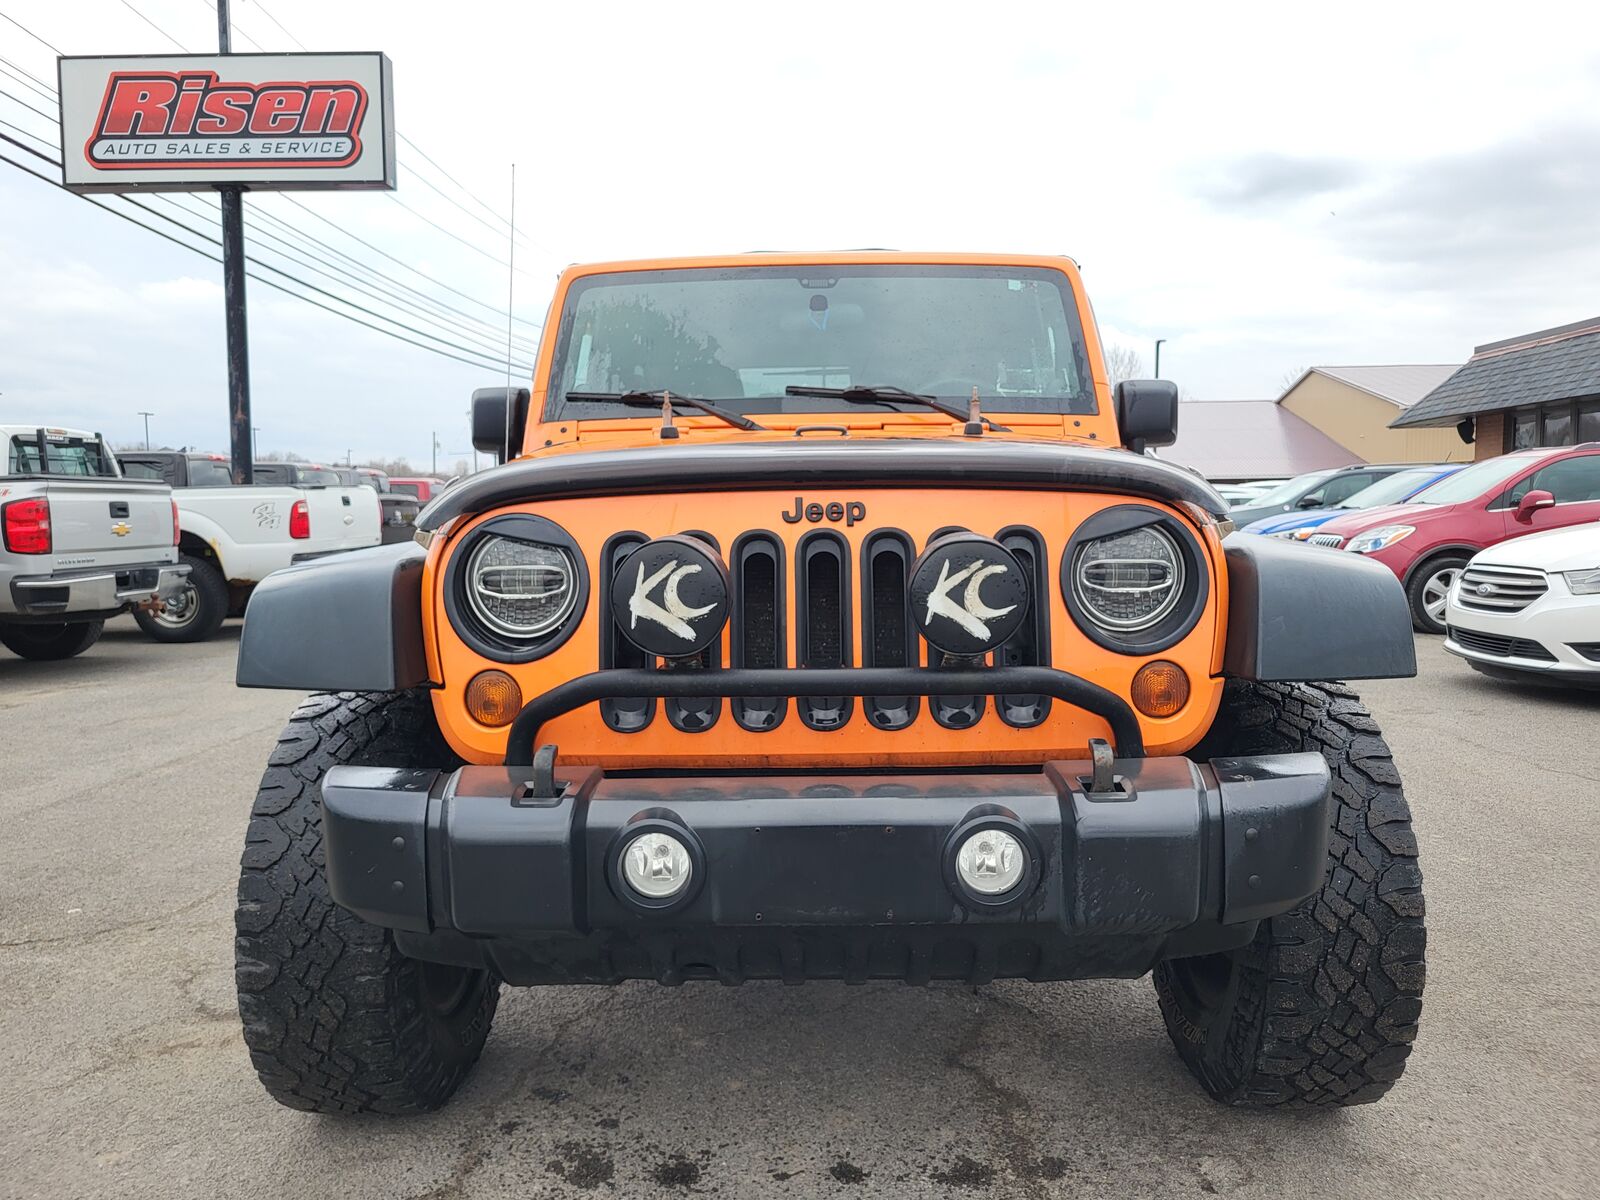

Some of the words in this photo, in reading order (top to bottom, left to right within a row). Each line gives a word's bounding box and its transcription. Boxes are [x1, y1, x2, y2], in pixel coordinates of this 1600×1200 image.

[102, 78, 359, 136] Risen
[103, 143, 157, 155] AUTO
[166, 142, 231, 155] SALES
[239, 142, 251, 154] &
[260, 141, 346, 154] SERVICE
[782, 497, 866, 527] Jeep
[629, 560, 718, 642] KC
[925, 558, 1018, 642] KC
